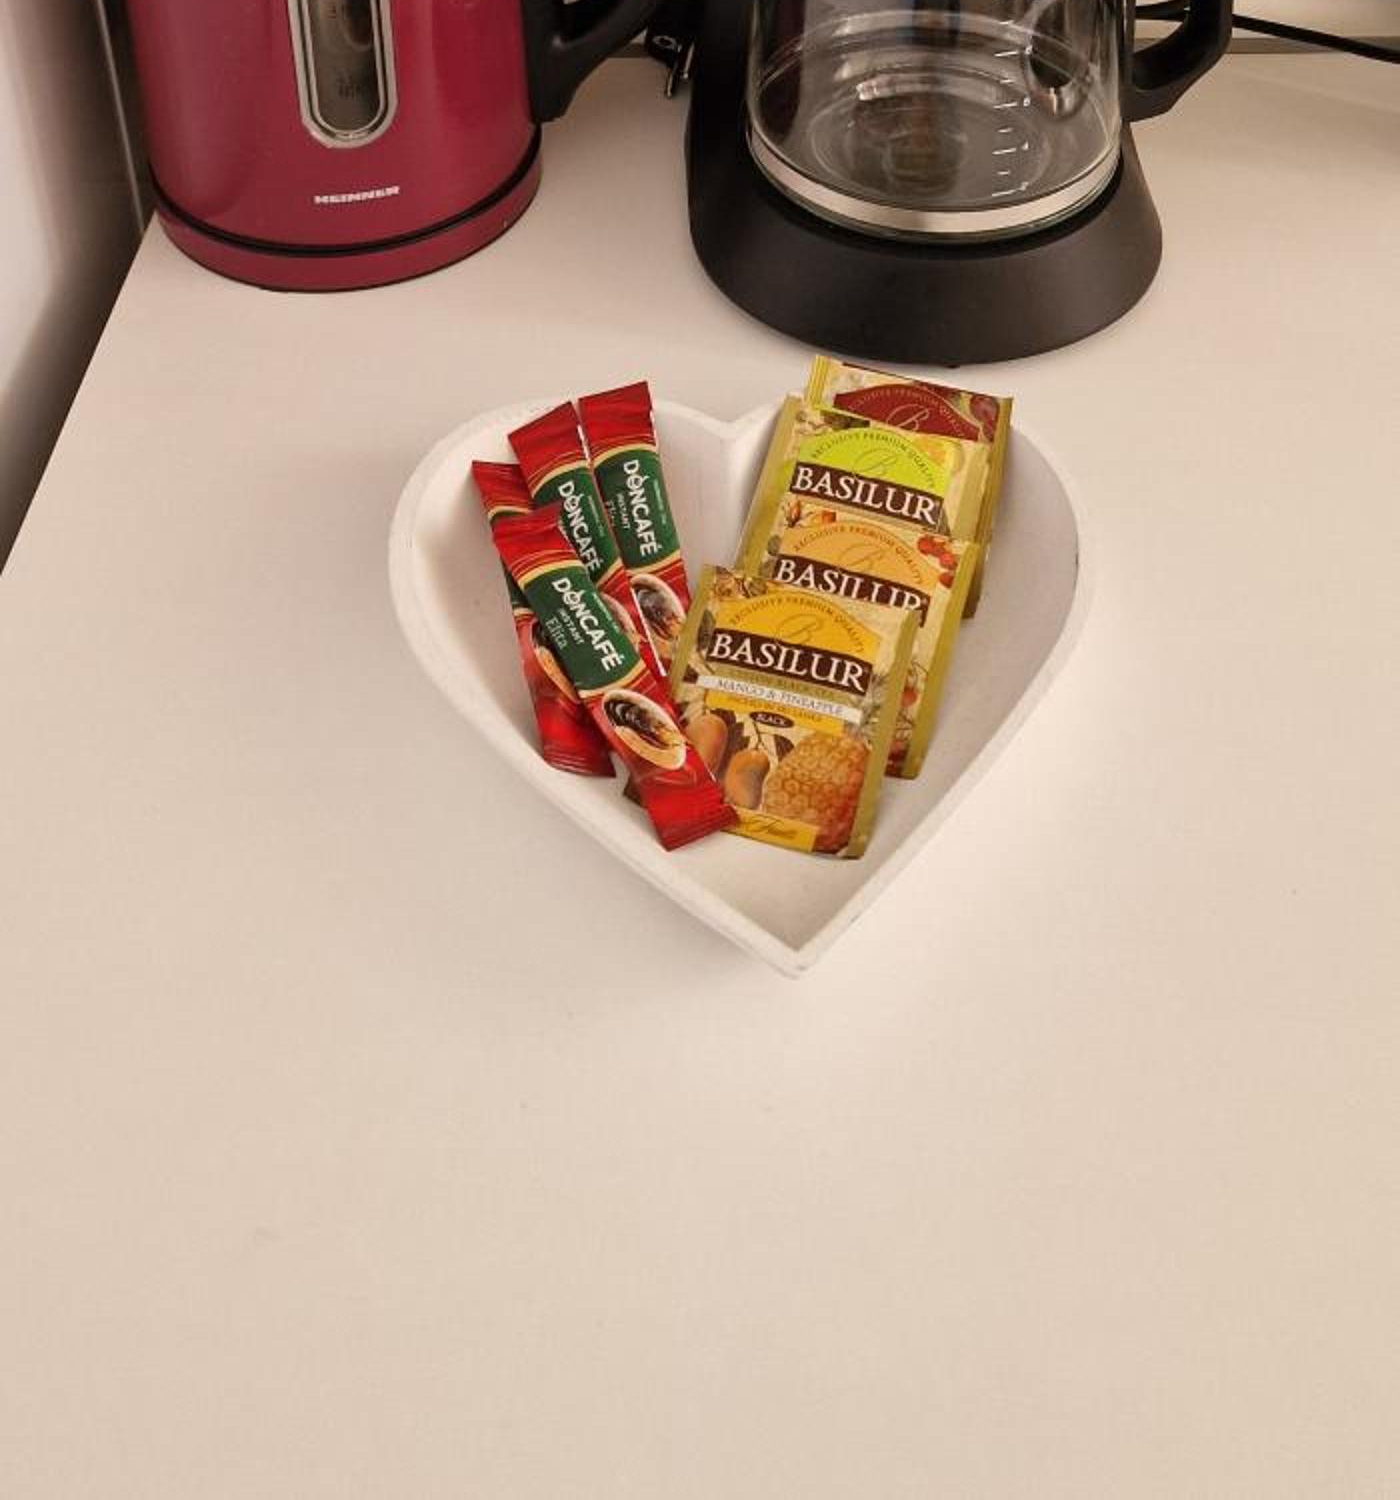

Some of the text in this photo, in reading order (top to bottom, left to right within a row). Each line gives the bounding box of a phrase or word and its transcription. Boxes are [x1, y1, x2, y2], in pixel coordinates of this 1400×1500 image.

[792, 466, 937, 526] BASILUR
[710, 632, 866, 693] BASILUR
[716, 678, 764, 696] MANGO
[780, 691, 844, 715] PINEAPPLE
[755, 712, 787, 726] BLACK
